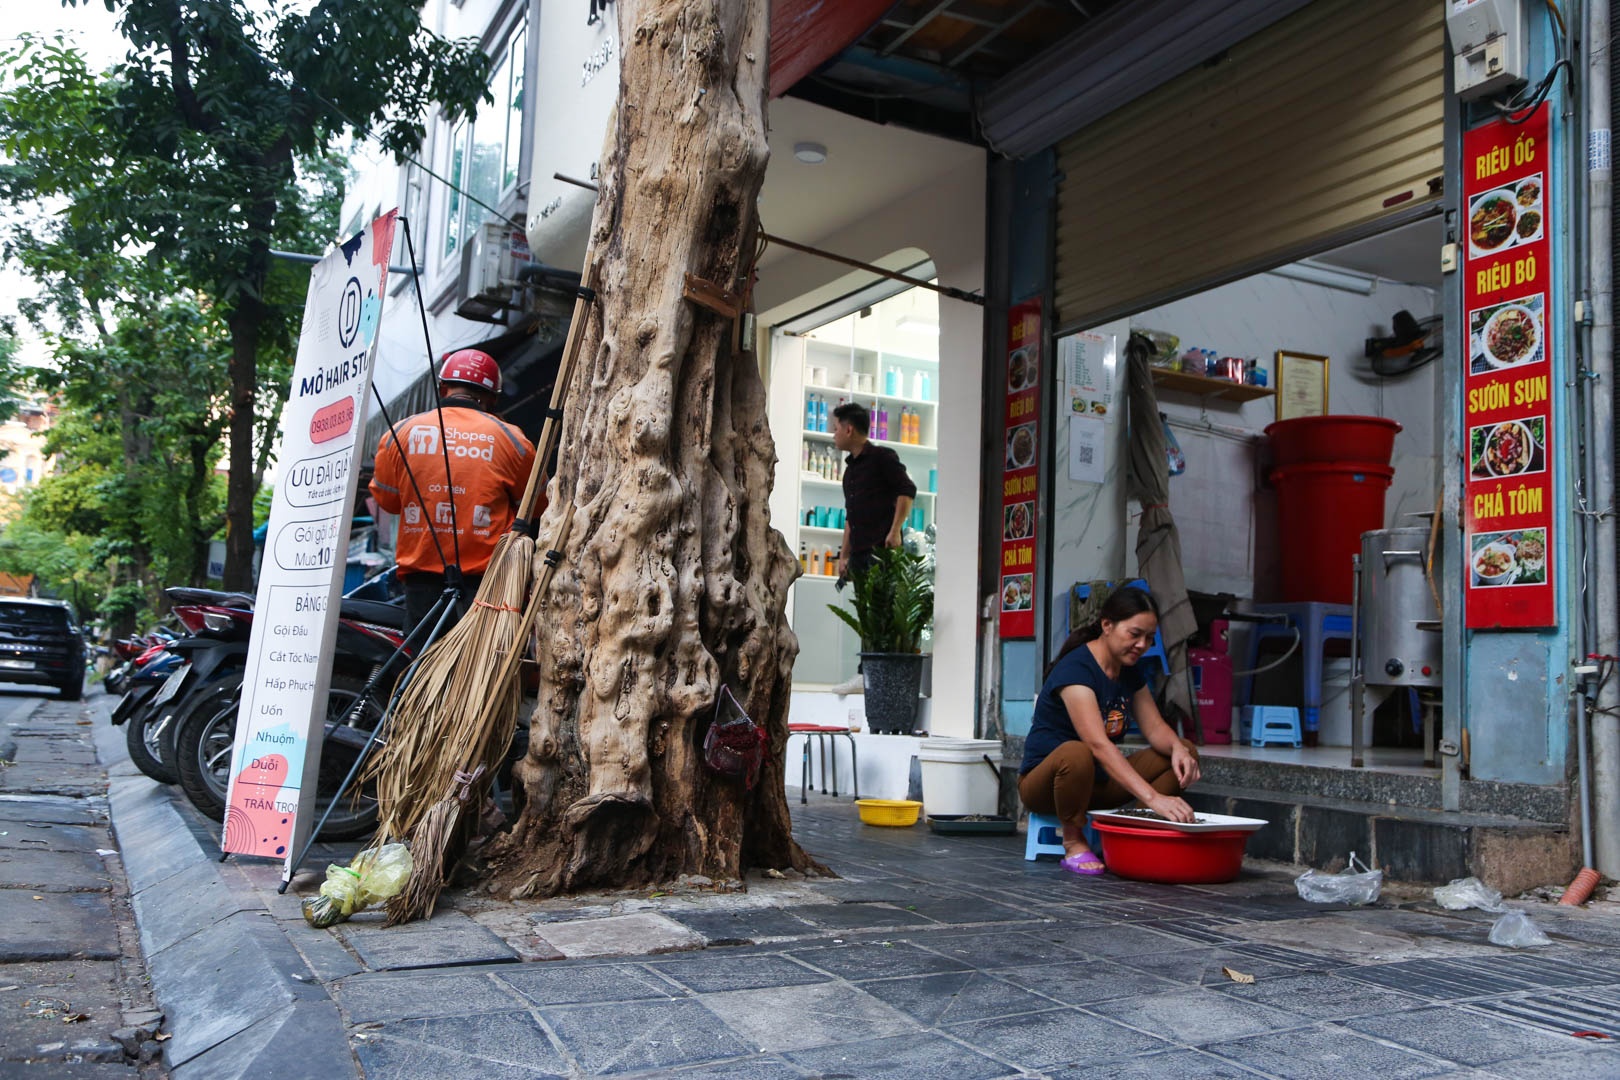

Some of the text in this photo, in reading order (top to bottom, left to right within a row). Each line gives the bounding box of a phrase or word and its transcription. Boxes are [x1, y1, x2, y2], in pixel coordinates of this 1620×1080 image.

[1476, 131, 1535, 181] RIÊU ỐC
[1476, 250, 1536, 296] RIÊU BÒ
[325, 360, 350, 391] HAIR
[1468, 375, 1547, 414] SƯỜN SỤN
[444, 427, 495, 444] Shopee
[441, 439, 495, 462] Food
[291, 466, 315, 487] ƯU
[428, 483, 442, 493] CÓ
[1474, 483, 1543, 519] CHẢ TÔM
[294, 526, 314, 543] Gói
[294, 546, 331, 567] Mua 10
[1004, 543, 1032, 567] CHẢ TÔM
[295, 592, 321, 613] BẢNG
[273, 625, 291, 638] Gội
[288, 652, 303, 663] Tóc
[265, 677, 286, 692] Hấp
[260, 703, 283, 717] Uốn
[256, 731, 295, 748] Nhuộm
[251, 758, 279, 771] Duỗi
[243, 797, 274, 812] TRÂN
